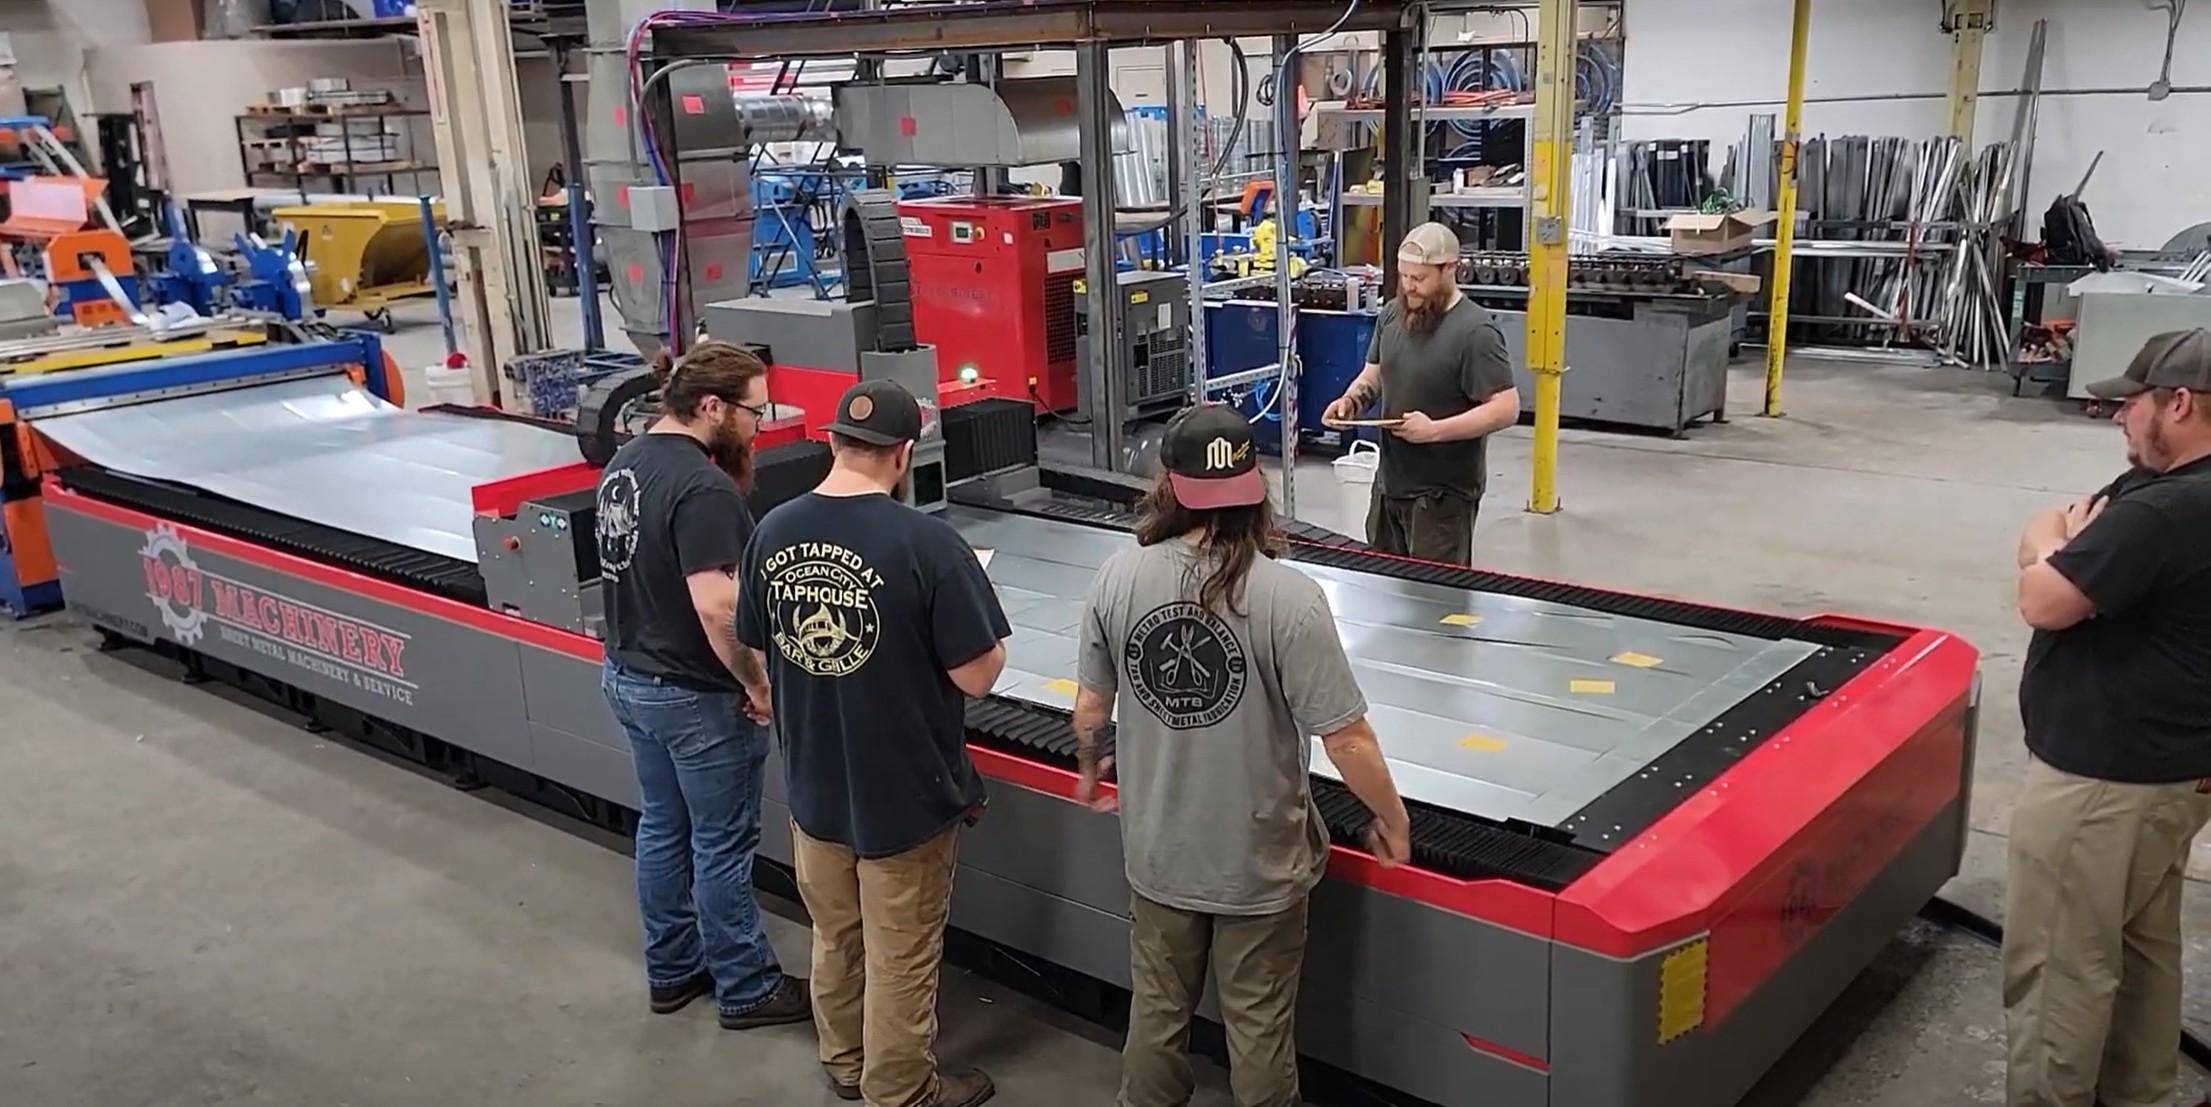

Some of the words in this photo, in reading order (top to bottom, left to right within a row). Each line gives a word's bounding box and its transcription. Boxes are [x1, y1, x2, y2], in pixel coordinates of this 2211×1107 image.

[765, 545, 797, 572] GOT
[799, 542, 863, 570] TAPPED
[860, 567, 885, 589] AT
[785, 565, 830, 583] OCEAN
[830, 568, 857, 590] CITY
[770, 580, 869, 610] TAPHOUSE
[143, 555, 203, 611] 1987
[210, 579, 405, 678] MACHINERY
[1133, 613, 1161, 642] METRO
[1160, 605, 1185, 620] TEST
[1186, 605, 1205, 621] AND
[775, 631, 804, 663] BAR
[804, 656, 816, 671] &
[252, 636, 286, 661] METAL
[287, 649, 349, 683] MACHINERY
[352, 672, 362, 687] &
[362, 676, 414, 706] SERVICE
[1134, 682, 1151, 700] AND
[1164, 696, 1203, 709] MTB
